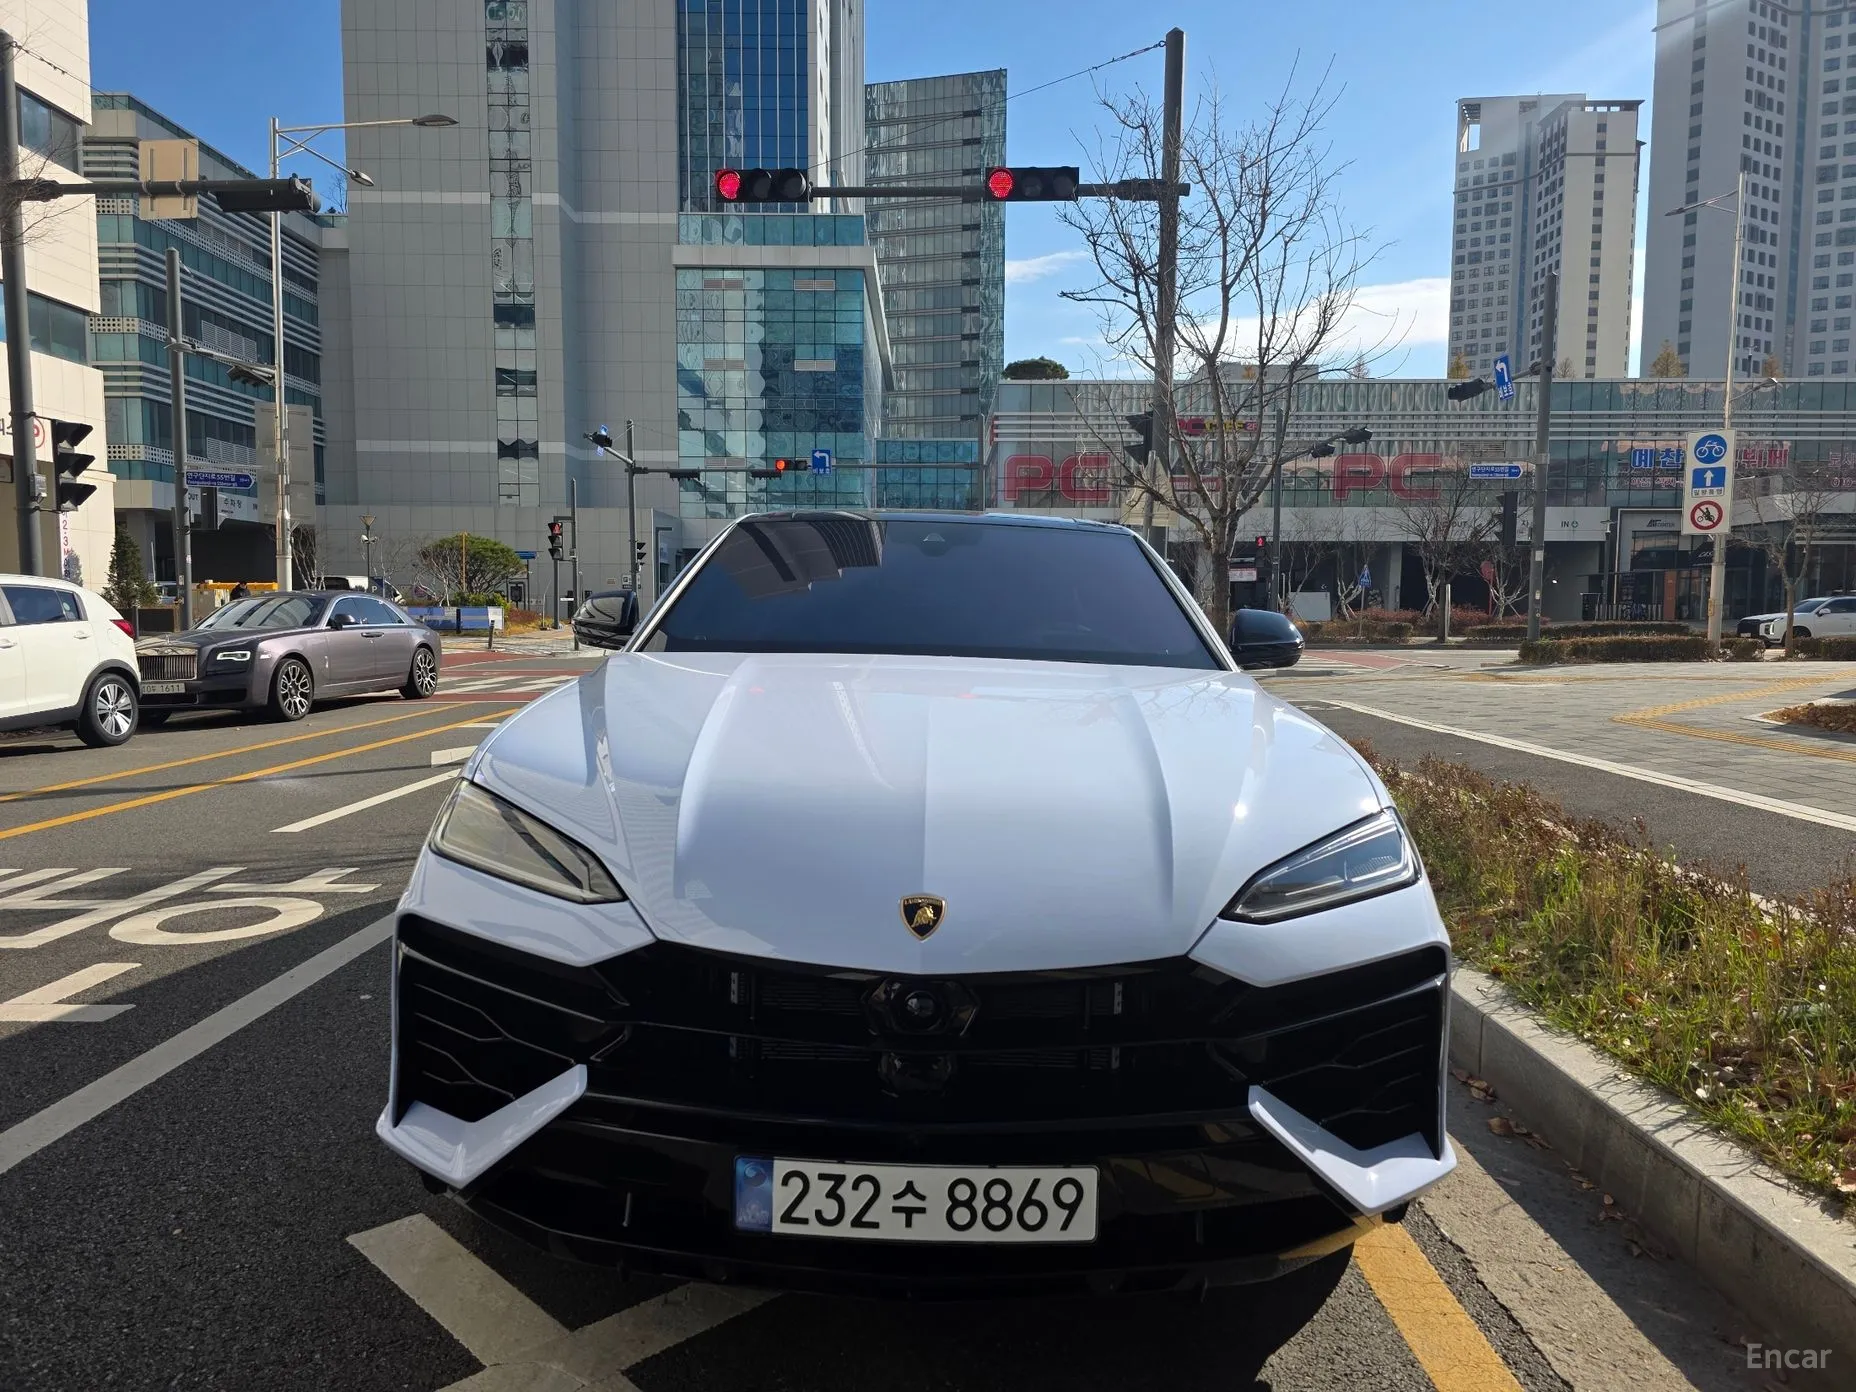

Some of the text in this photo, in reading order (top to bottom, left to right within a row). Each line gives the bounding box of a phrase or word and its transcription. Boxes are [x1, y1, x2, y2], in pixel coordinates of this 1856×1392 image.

[1004, 455, 1110, 500] PC
[1334, 453, 1441, 500] PC
[779, 1170, 1085, 1232] 232수 8869
